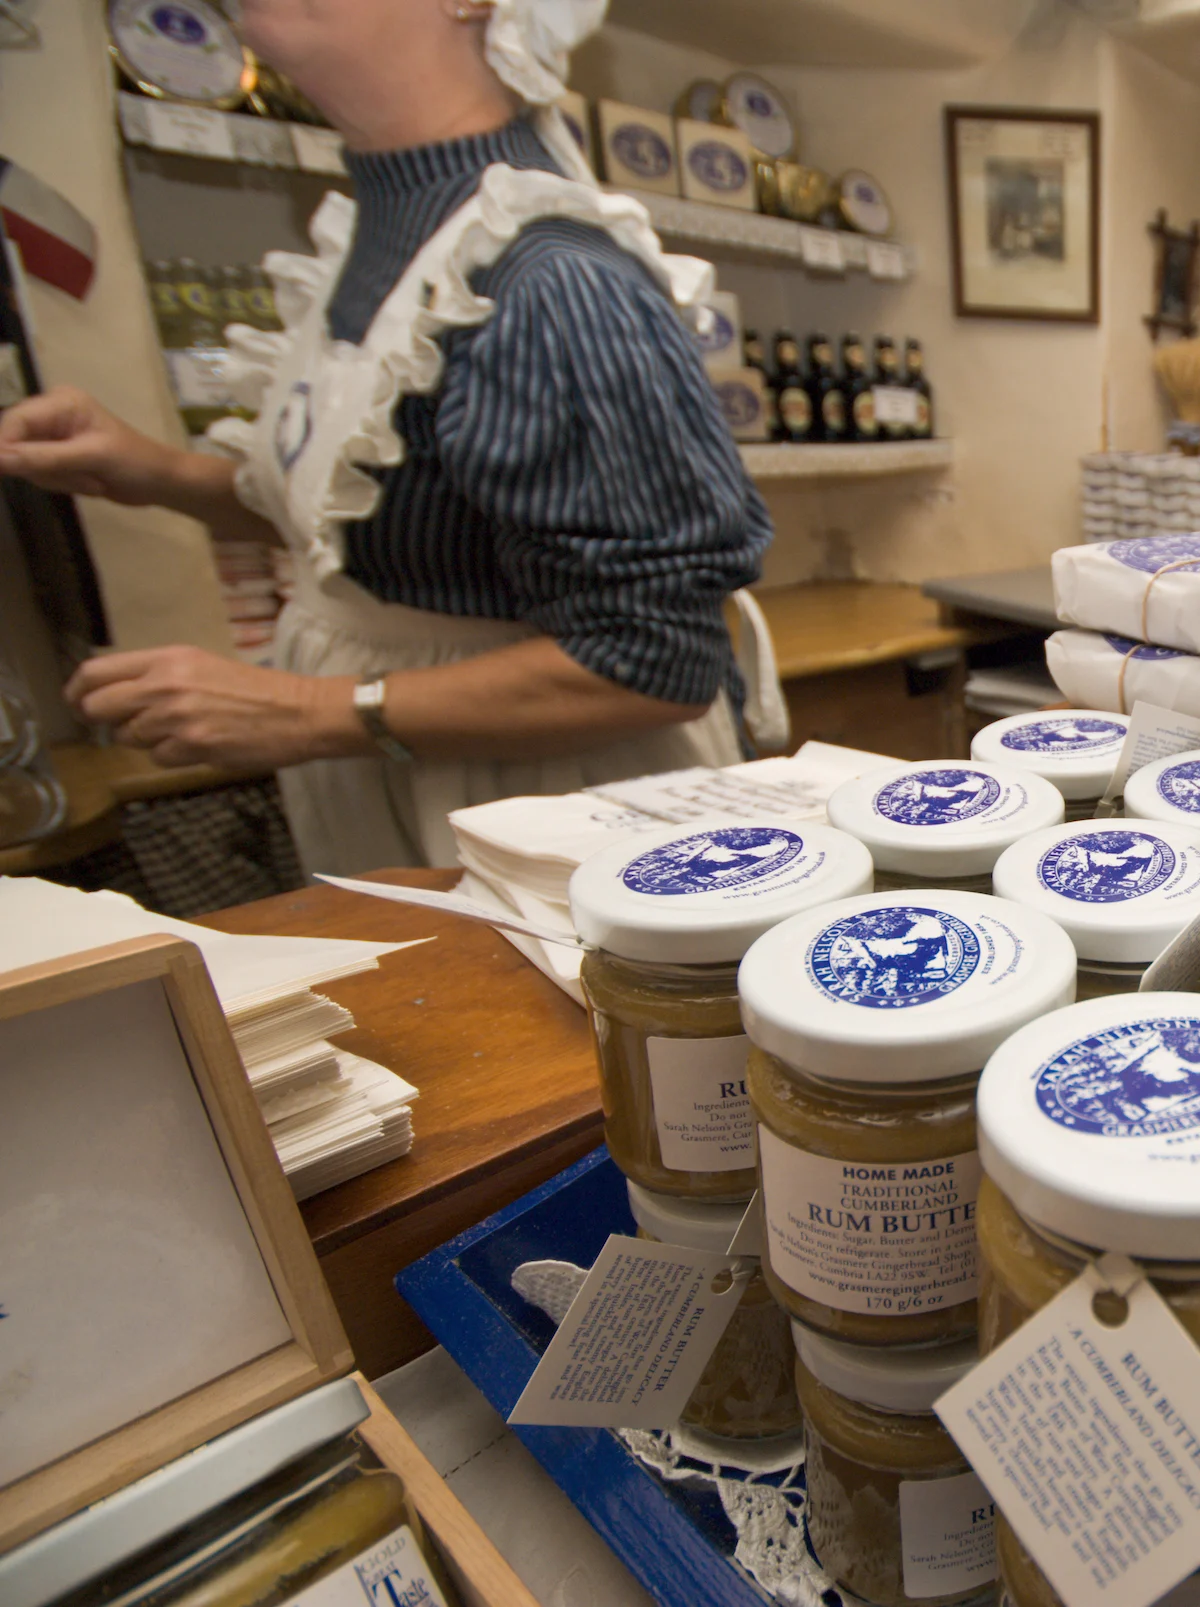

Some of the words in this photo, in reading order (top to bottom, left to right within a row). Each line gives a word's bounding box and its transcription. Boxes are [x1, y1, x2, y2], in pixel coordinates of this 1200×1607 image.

[624, 853, 657, 881] SARAH
[1042, 864, 1069, 893] SARAH
[684, 875, 758, 894] GRASMERE
[1124, 874, 1168, 898] GRASMERE
[975, 923, 988, 934] 1854
[816, 967, 864, 1003] SARAH
[939, 954, 978, 992] GRASMERE
[1039, 1039, 1092, 1091] SARAH
[664, 1122, 689, 1132] Sarah
[692, 1123, 731, 1132] Nelson's
[710, 1112, 726, 1122] Do
[1102, 1115, 1200, 1137] GRASMERE
[843, 1166, 897, 1181] HOME
[903, 1162, 955, 1181] MADE
[840, 1180, 958, 1198] TRADITIONAL
[840, 1193, 958, 1212] CUMBERLAND
[807, 1202, 872, 1232] RUM
[800, 1232, 813, 1243] Do
[817, 1239, 832, 1251] not
[898, 1248, 926, 1258] Store
[930, 1245, 940, 1255] in
[880, 1236, 916, 1246] Butter
[920, 1232, 940, 1242] and
[819, 1263, 863, 1280] Cumbria
[821, 1251, 868, 1269] Grasmere
[871, 1256, 940, 1273] Gingerbread
[658, 1282, 700, 1352] CUMBERLAND
[865, 1297, 892, 1309] 170
[898, 1296, 922, 1311] g/6
[682, 1307, 704, 1335] RUM
[595, 1353, 628, 1401] Cumberland
[653, 1340, 688, 1391] BUTTER
[1122, 1352, 1157, 1396] RUM
[586, 1367, 611, 1401] delicious
[629, 1355, 663, 1406] DELICACY
[1079, 1338, 1153, 1438] CUMBERLAND
